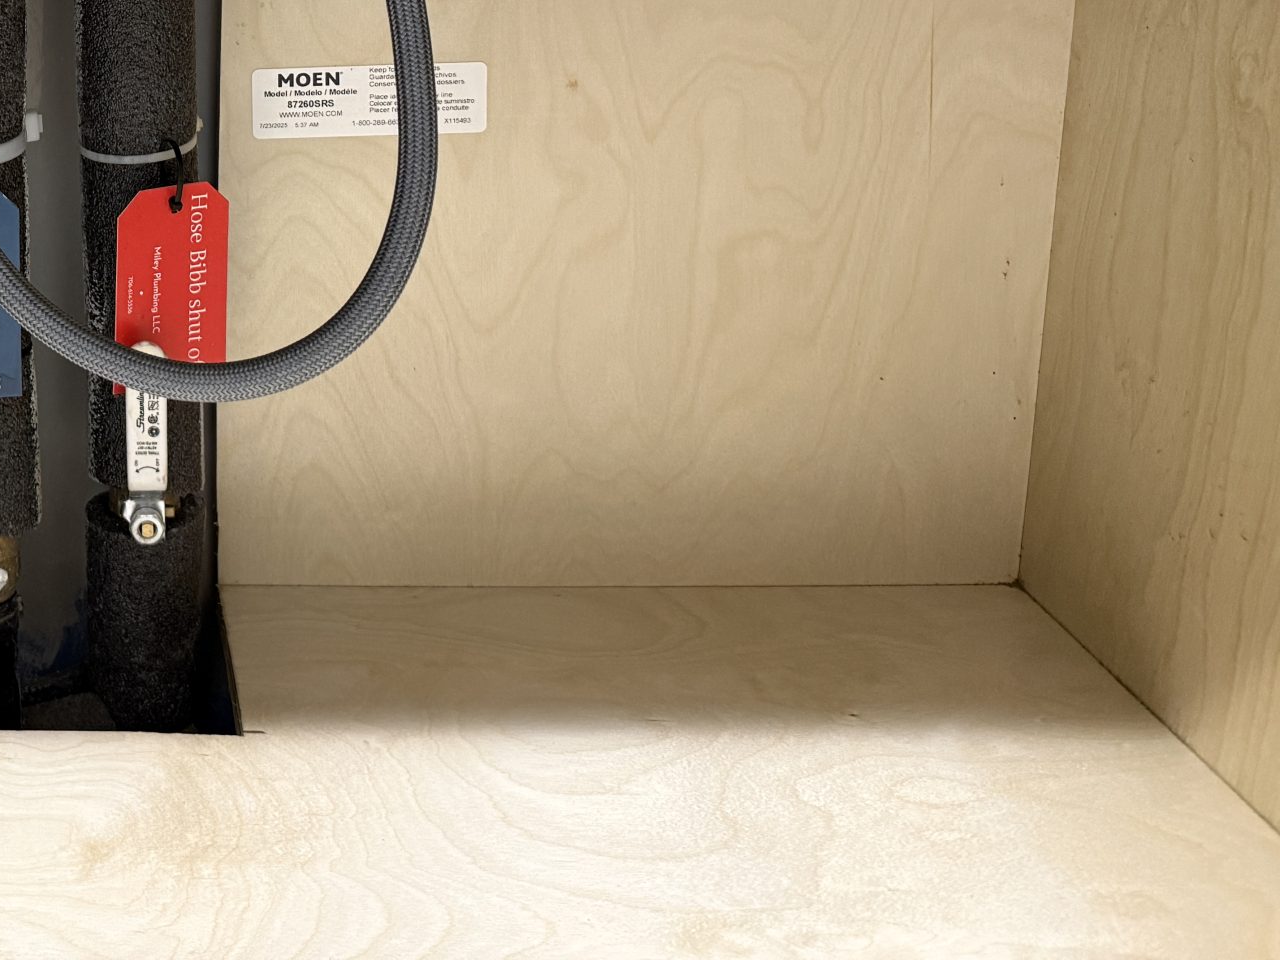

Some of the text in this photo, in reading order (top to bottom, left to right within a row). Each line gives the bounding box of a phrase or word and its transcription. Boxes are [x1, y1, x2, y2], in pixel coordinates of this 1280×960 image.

[277, 71, 340, 87] MOEN
[287, 99, 335, 108] 87260SRS
[189, 193, 208, 244] Hose
[151, 246, 162, 334] Miley Plumbing LLC
[188, 249, 207, 295] Bibb
[188, 300, 206, 343] shut
[136, 391, 145, 433] Streamlin
